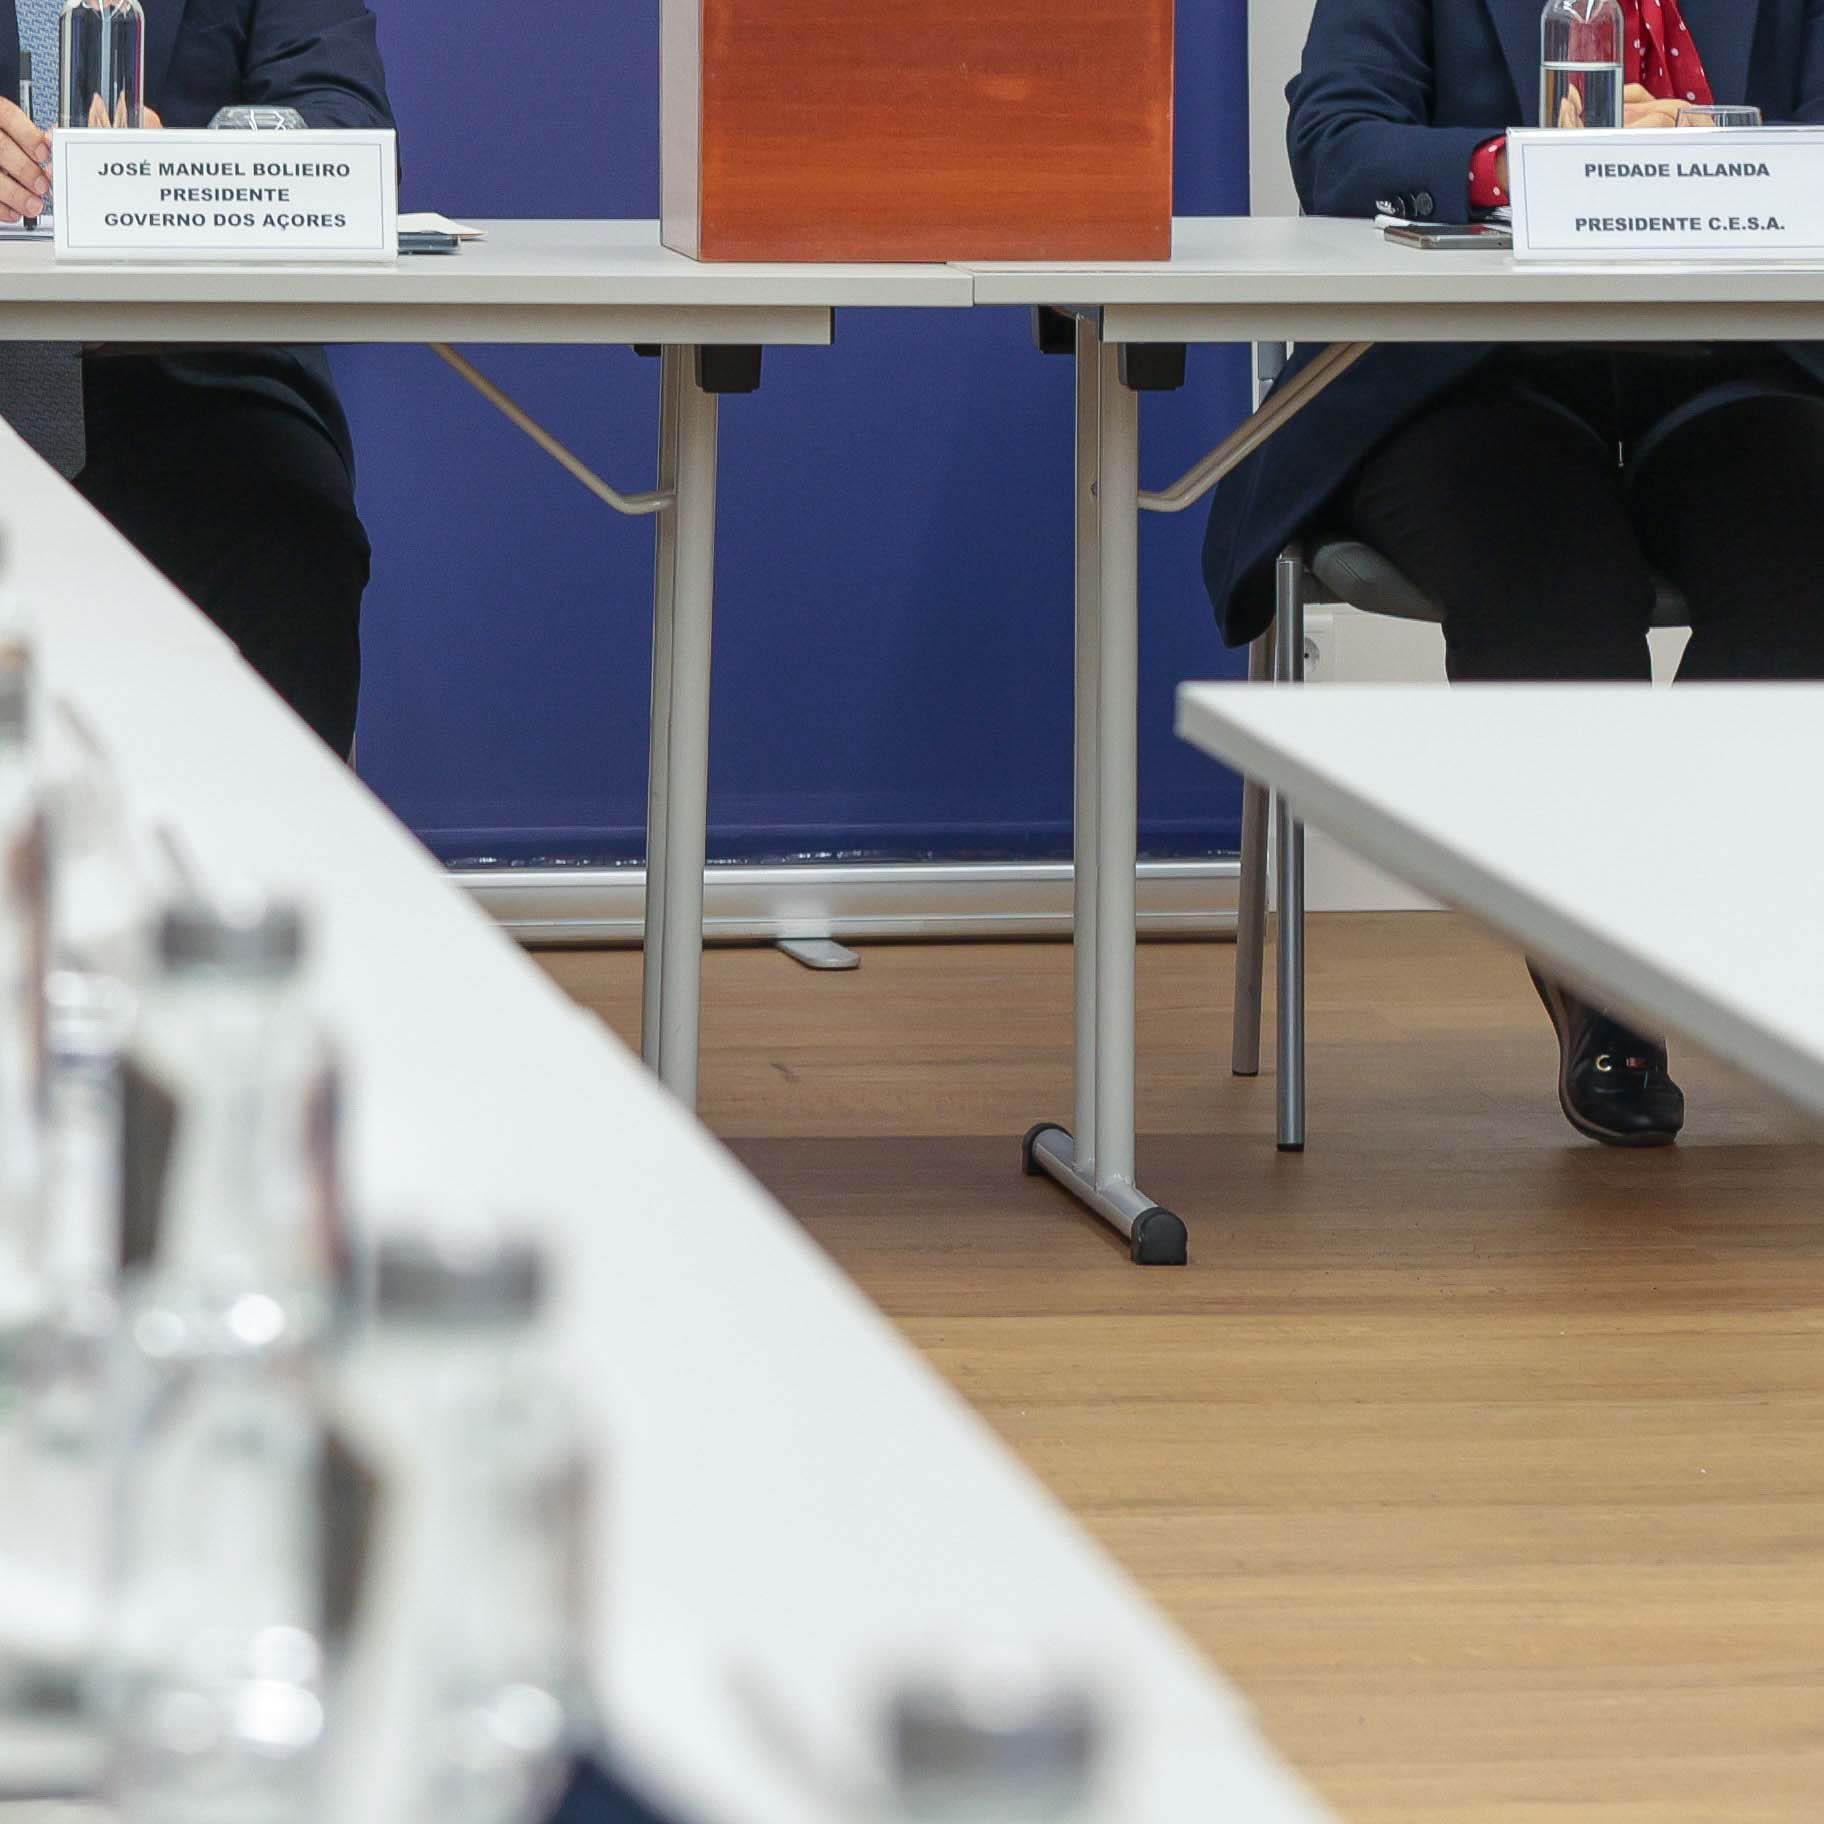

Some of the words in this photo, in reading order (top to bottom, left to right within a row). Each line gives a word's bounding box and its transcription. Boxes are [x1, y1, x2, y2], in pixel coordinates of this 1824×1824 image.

[97, 160, 152, 177] JOSÉ
[158, 162, 247, 177] MANUEL
[253, 163, 351, 177] BOLIEIRO
[1584, 163, 1671, 178] PIEDADE
[1676, 163, 1771, 177] LALANDA
[160, 188, 291, 202] PRESIDENTE
[104, 213, 207, 227] GOVERNO
[213, 213, 256, 227] DOS
[262, 213, 347, 231] AÇORES
[1575, 217, 1703, 232] PRESIDENTE
[1708, 216, 1786, 231] C.E.S.A.
